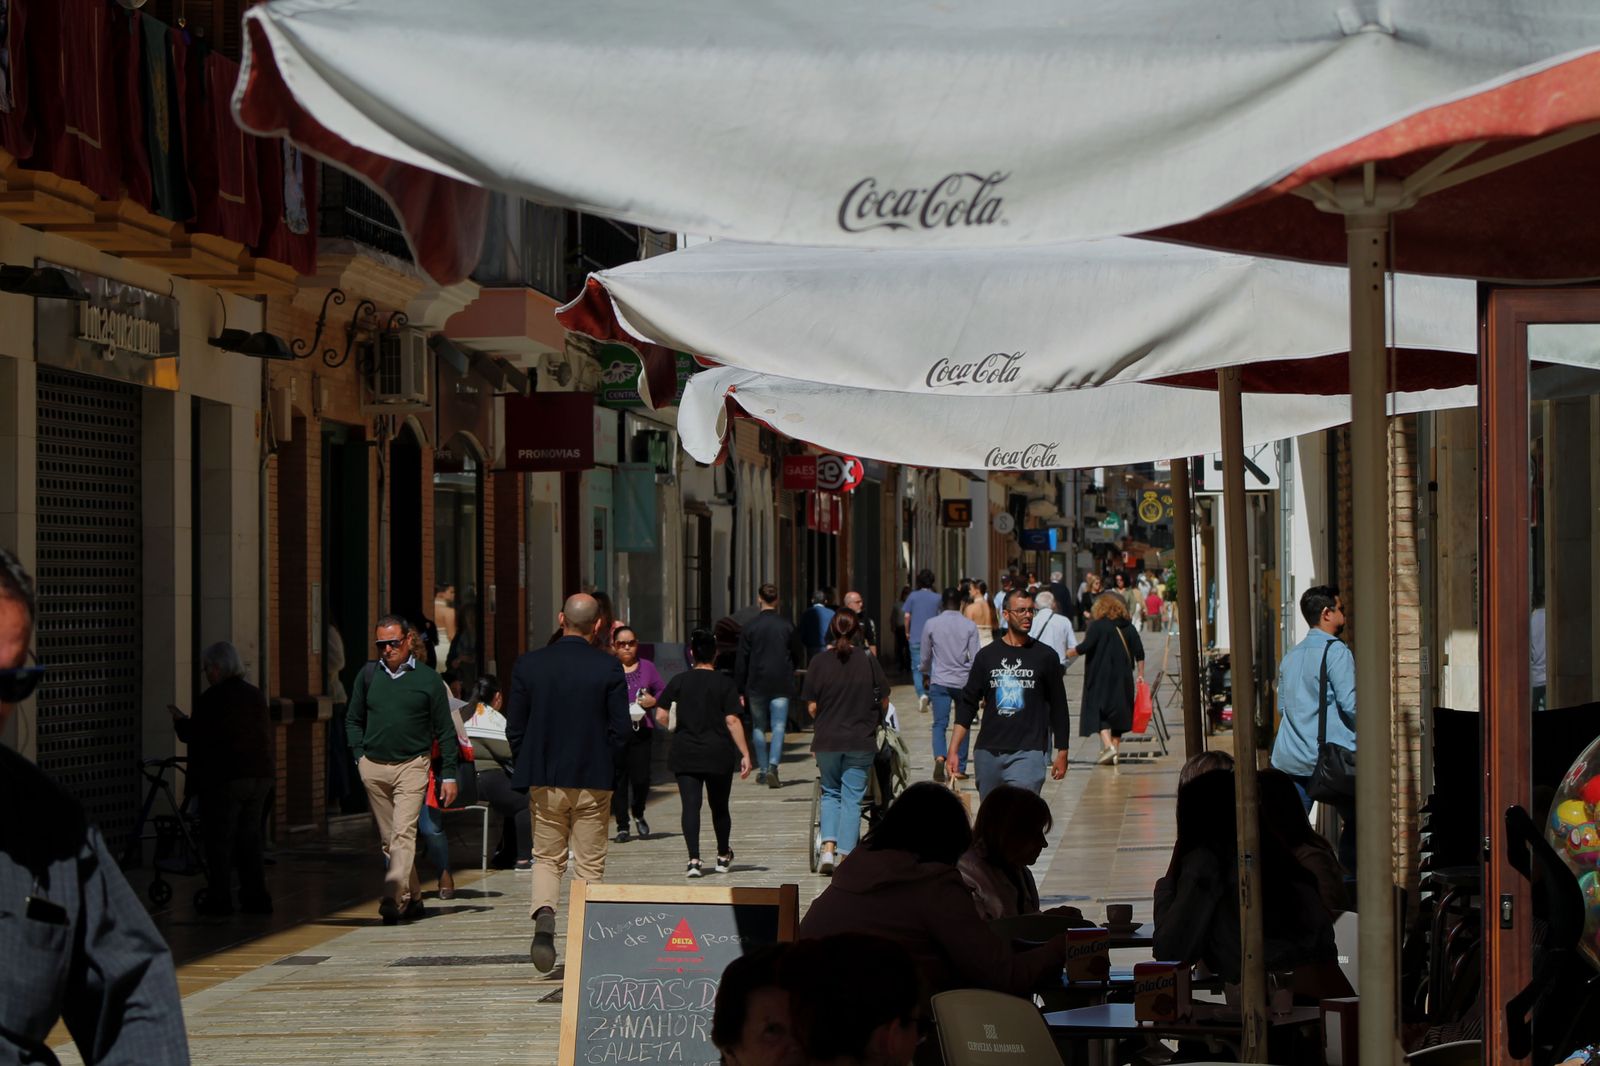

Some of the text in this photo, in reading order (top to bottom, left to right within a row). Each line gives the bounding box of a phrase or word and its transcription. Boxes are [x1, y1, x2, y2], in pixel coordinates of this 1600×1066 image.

[838, 171, 1010, 233] Coca-Cola
[926, 351, 1026, 388] Coca-Cola
[518, 449, 581, 459] PRONOVIAS
[984, 442, 1060, 469] Coca-Cola
[785, 465, 815, 476] GAES
[990, 679, 1035, 689] PATNUM
[624, 934, 649, 947] de
[671, 937, 693, 945] DELTA
[596, 980, 686, 1010] TARTAS
[587, 1012, 713, 1042] ZANAHOR
[587, 1041, 683, 1065] GALLETA
